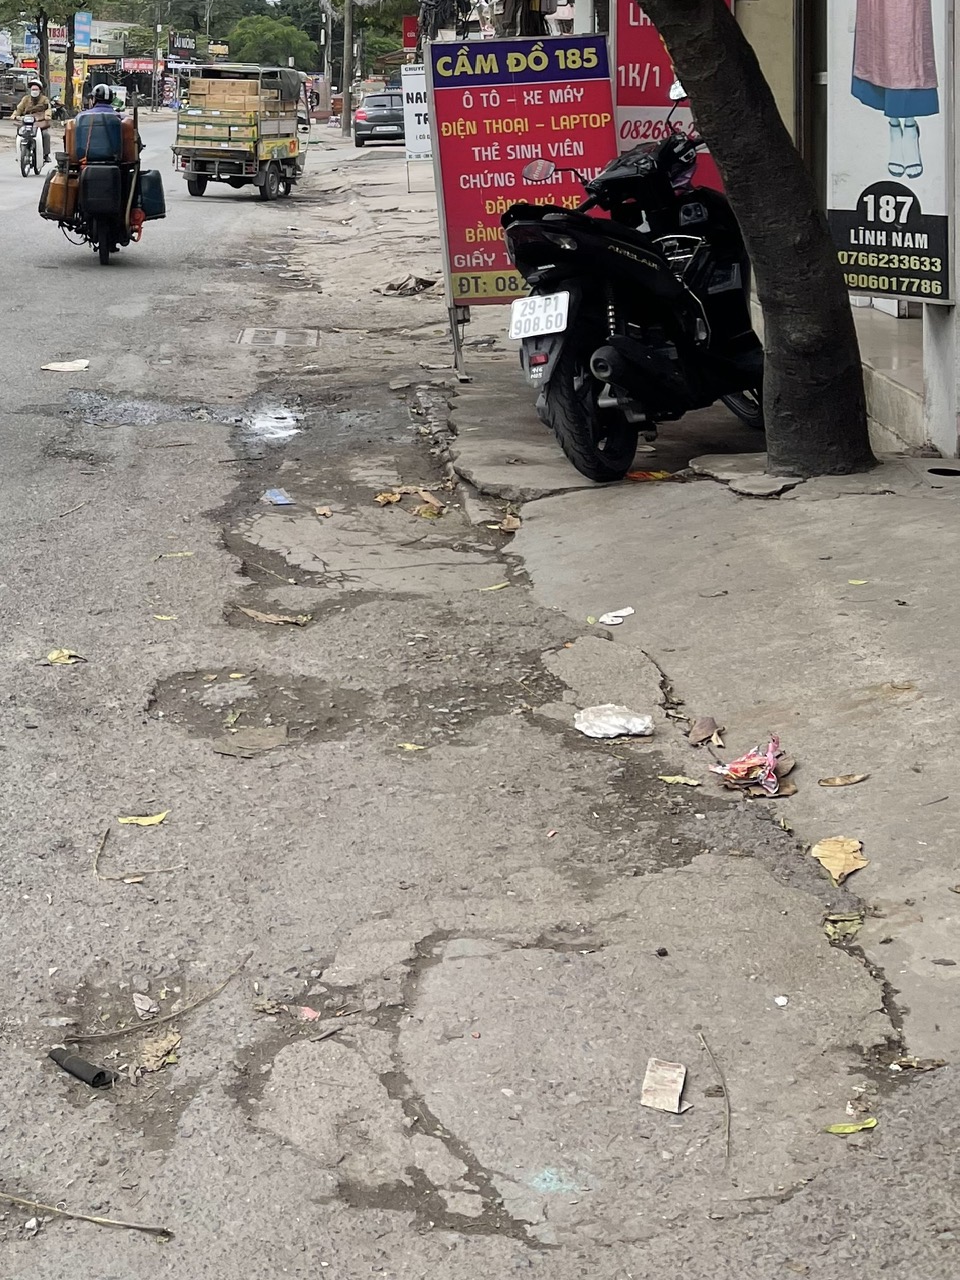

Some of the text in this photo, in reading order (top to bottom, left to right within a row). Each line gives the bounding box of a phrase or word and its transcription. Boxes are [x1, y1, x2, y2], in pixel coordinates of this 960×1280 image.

[436, 41, 598, 77] CẦM ĐỒ 185
[618, 63, 660, 92] 1K/1
[462, 90, 474, 109] Ô
[480, 89, 501, 108] TÔ
[523, 90, 543, 105] XE
[549, 85, 584, 104] MÁY
[441, 117, 477, 139] ĐIỆN
[483, 117, 529, 136] THOẠI
[551, 113, 611, 131] LAPTOP
[472, 138, 584, 161] THẺ SINH VIÊN
[459, 170, 515, 189] CHỨNG
[863, 194, 914, 224] 187
[850, 226, 929, 249] LĨNH NAM
[454, 248, 496, 268] GIẤY
[837, 251, 942, 272] 0766233633
[458, 276, 488, 294] ĐT:
[844, 273, 942, 295] 906017786
[520, 295, 560, 318] 29-P1
[514, 313, 564, 336] 908.60
